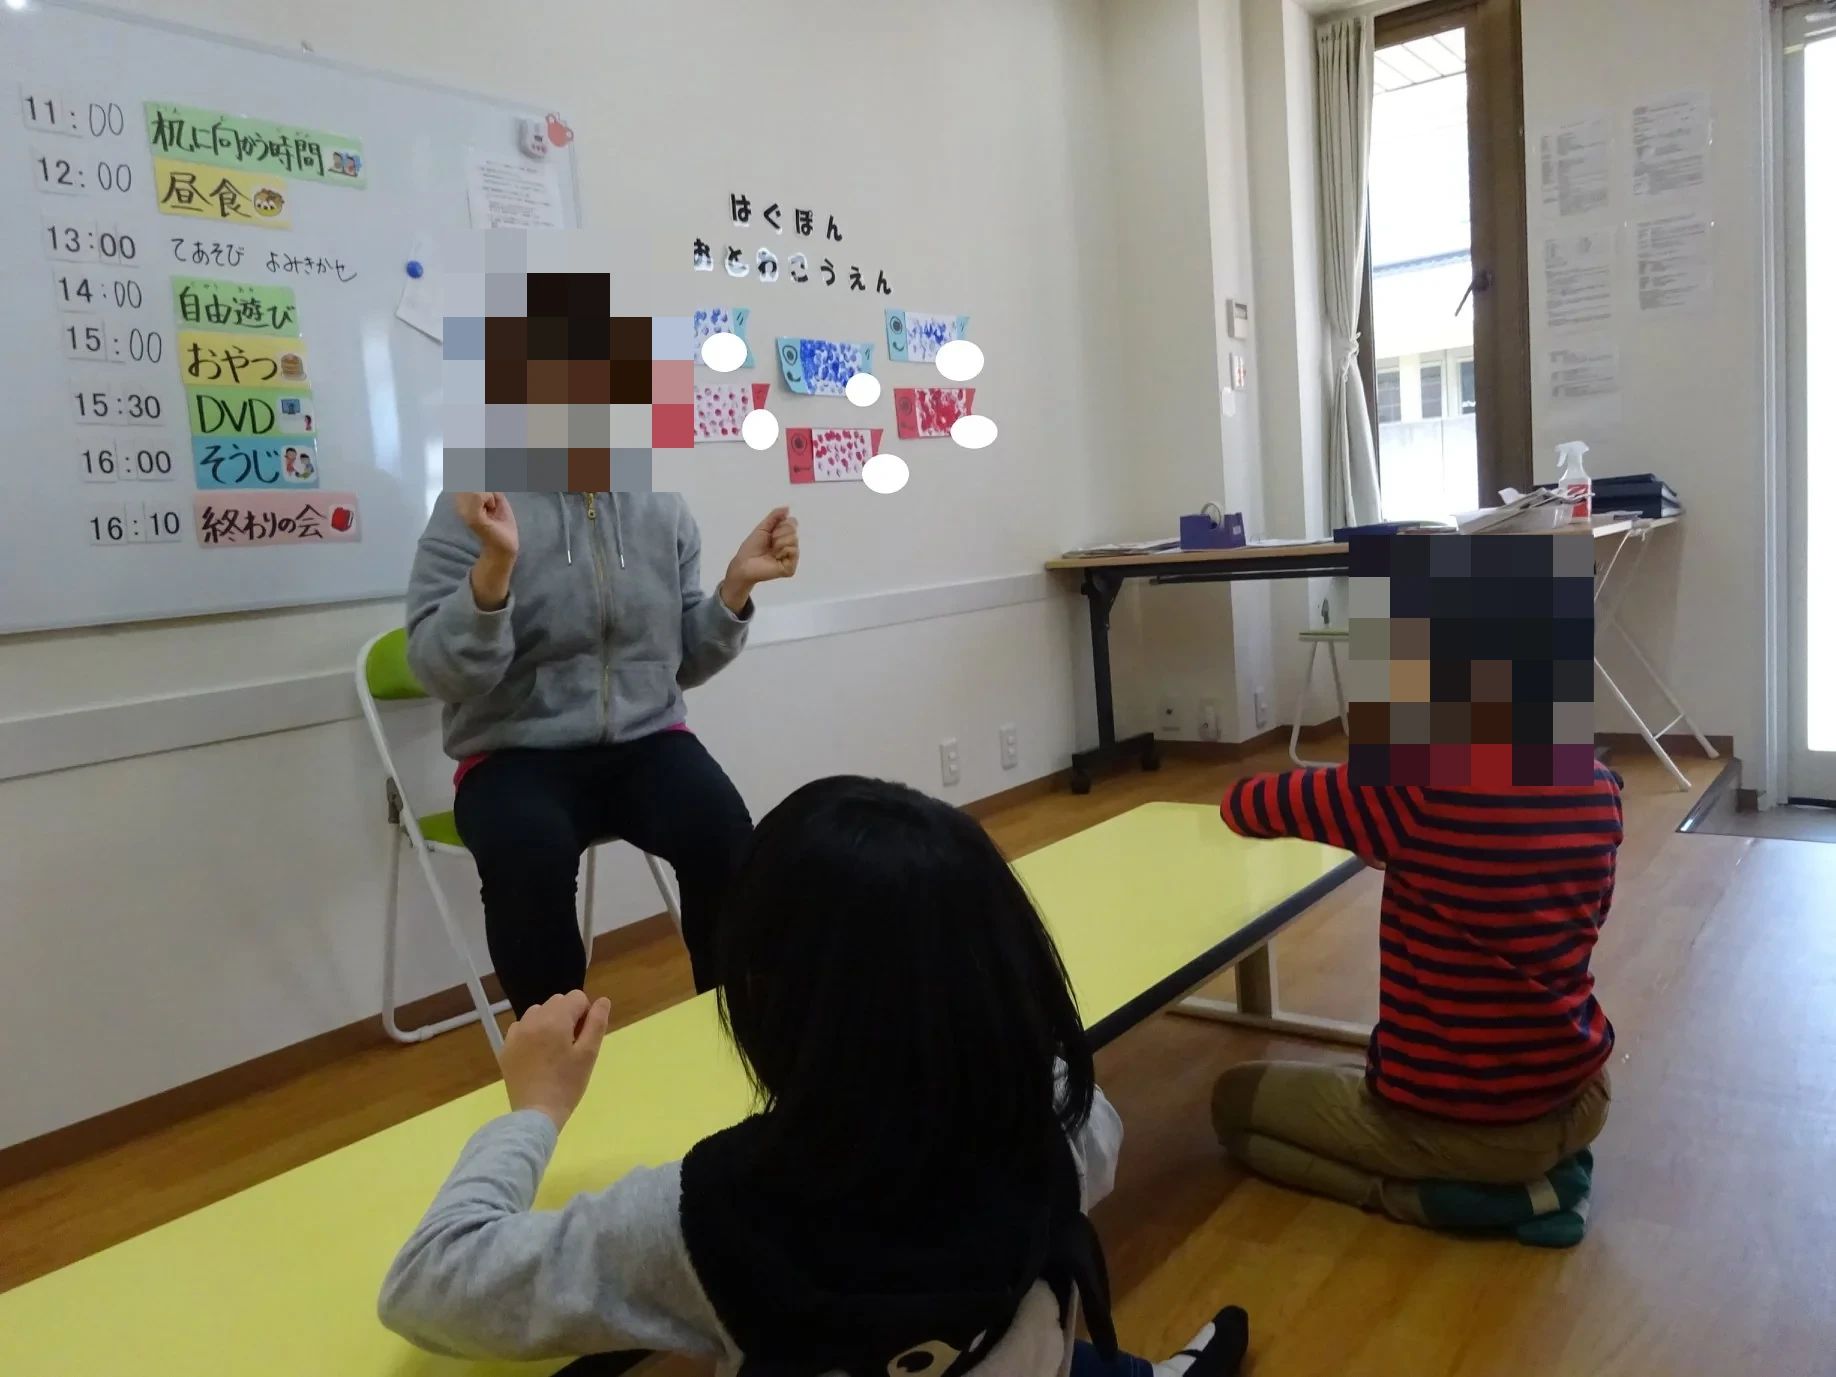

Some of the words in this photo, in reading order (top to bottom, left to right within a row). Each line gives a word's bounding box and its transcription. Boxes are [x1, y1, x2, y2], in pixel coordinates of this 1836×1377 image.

[25, 96, 124, 137] 11:00
[152, 110, 325, 176] 机に向かう時間
[37, 157, 132, 193] 12:00
[162, 171, 252, 218] 昼食
[731, 193, 842, 241] はぐぽん
[47, 226, 136, 260] 13:00
[171, 238, 244, 268] てあそび
[265, 252, 357, 283] よみきかせ
[58, 277, 142, 309] 14:00
[179, 286, 296, 329] 自由遊び
[66, 327, 163, 364] 15:00
[187, 343, 278, 384] おやつ
[75, 392, 161, 419] 15:30
[196, 394, 275, 435] DVD
[82, 450, 172, 476] 16:00
[199, 444, 280, 485] そうじ
[90, 511, 181, 542] 16:10
[202, 504, 324, 543] 終わりの会
